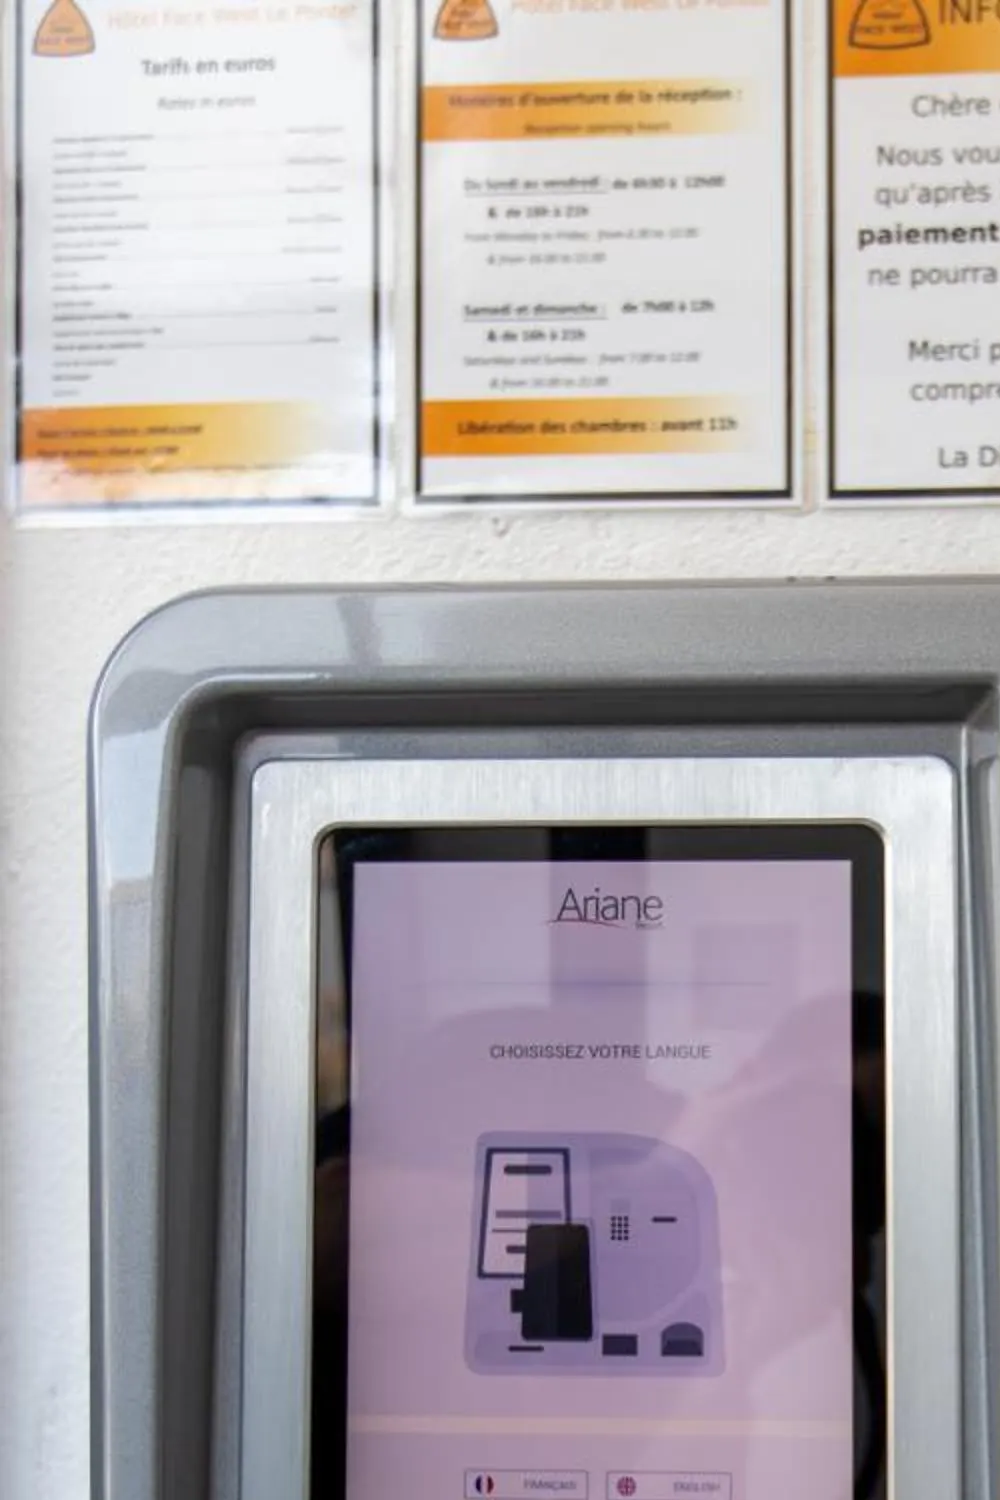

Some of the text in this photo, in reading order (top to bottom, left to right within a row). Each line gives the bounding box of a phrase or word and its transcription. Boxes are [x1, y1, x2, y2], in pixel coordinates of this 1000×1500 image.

[142, 56, 276, 77] Tarifs en euros
[615, 91, 634, 104] de
[911, 94, 992, 119] Chère
[876, 144, 943, 168] Nous
[875, 180, 992, 208] qu'après
[857, 222, 1000, 251] paiement
[867, 267, 901, 286] ne
[909, 264, 998, 289] pourra
[907, 339, 982, 363] Merci
[457, 417, 536, 436] Libération
[540, 416, 567, 435] des
[571, 416, 647, 434] chambres
[660, 417, 705, 433] avant
[709, 415, 738, 432] 11h
[937, 446, 969, 469] La
[555, 886, 664, 922] Ariane
[489, 1044, 712, 1061] CHOISISSEZ VOTRE LANGUE
